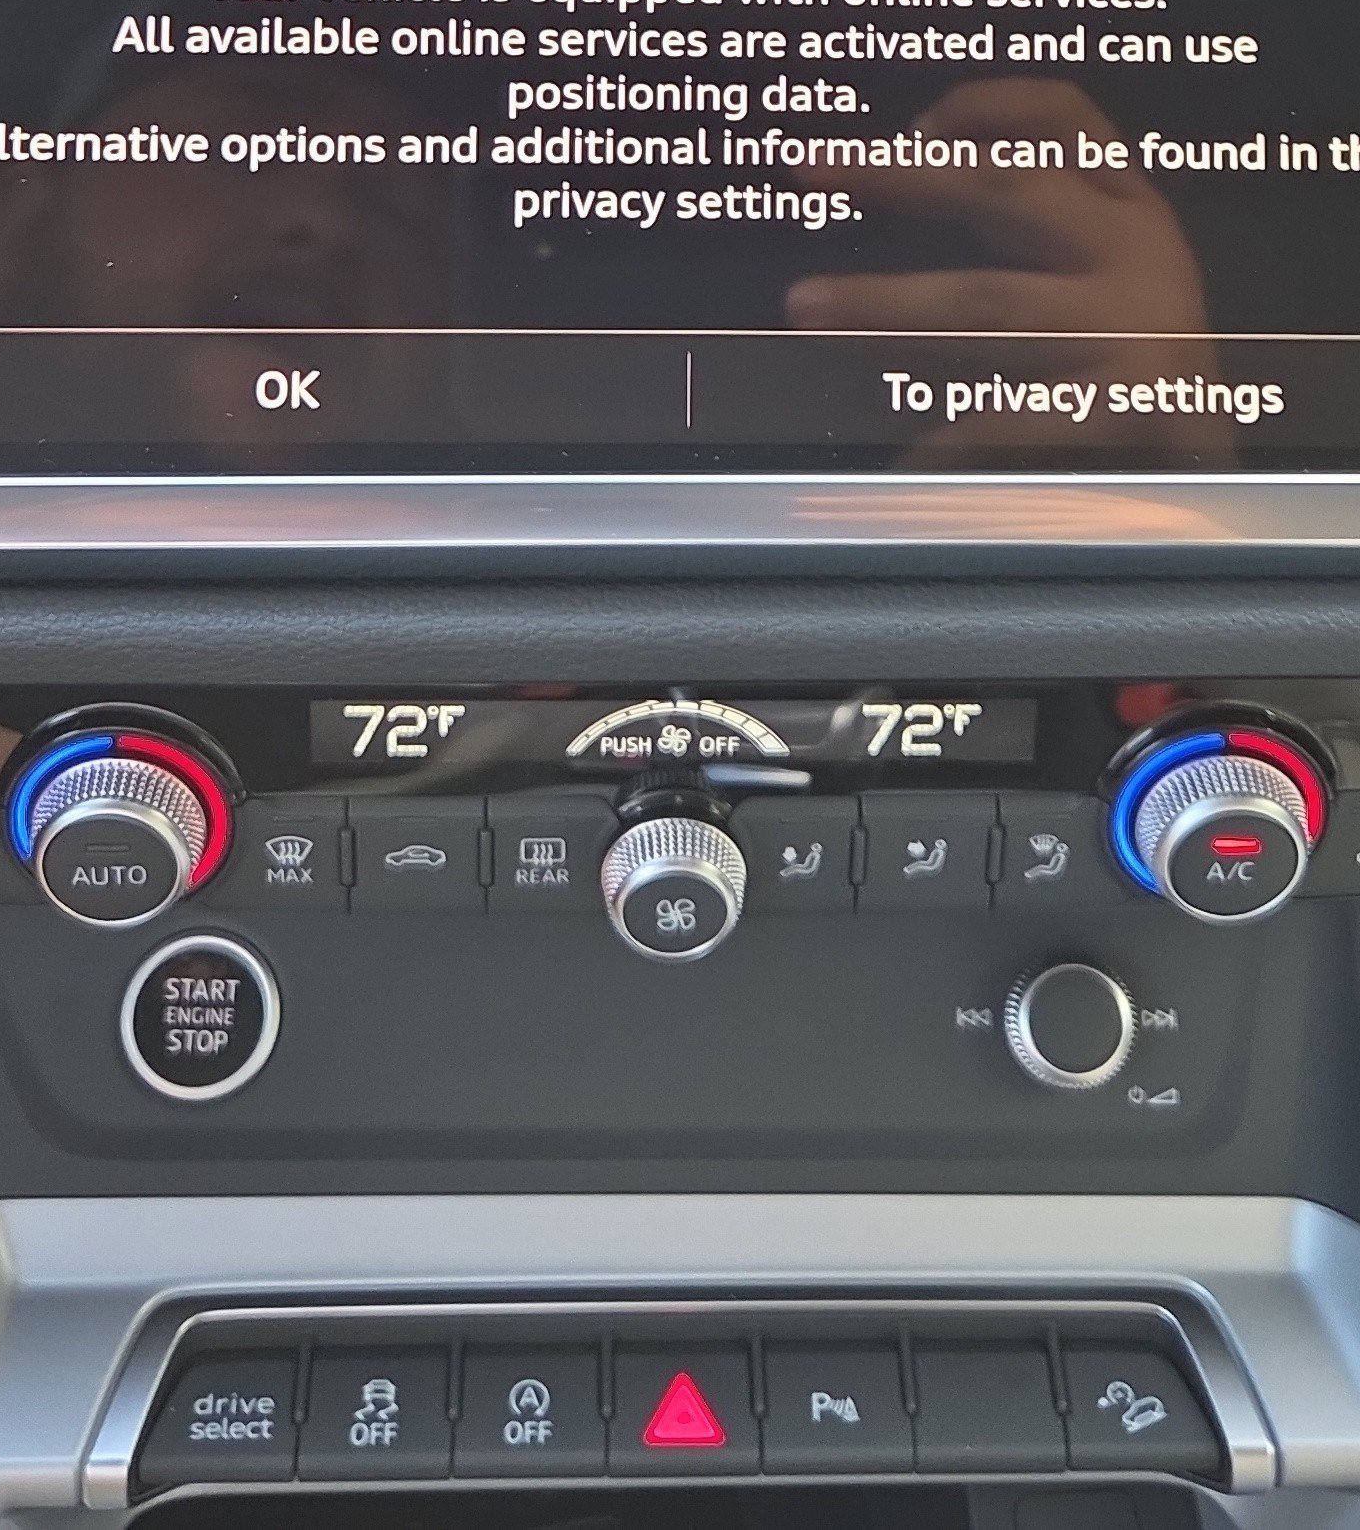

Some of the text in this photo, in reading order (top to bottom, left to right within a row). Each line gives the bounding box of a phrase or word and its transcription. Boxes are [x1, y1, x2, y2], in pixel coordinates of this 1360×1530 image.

[112, 15, 1259, 64] All available online services are activated and can use
[508, 73, 870, 121] positioning data.
[220, 125, 386, 173] options
[398, 125, 478, 164] and
[491, 126, 712, 165] additional
[723, 128, 978, 168] information
[990, 140, 1064, 169] can
[1077, 130, 1129, 169] be
[1138, 131, 1266, 171] found
[1279, 134, 1318, 171] in
[514, 181, 863, 230] privacy settings.
[255, 370, 321, 410] OK
[882, 372, 1285, 424] To privacy settings
[600, 734, 741, 758] PUSH OFF
[71, 864, 148, 887] AUTO
[266, 863, 315, 885] MAX
[515, 864, 570, 886] REAR
[1206, 860, 1257, 883] A/C
[164, 976, 241, 1003] START
[164, 1004, 236, 1028] ENGINE
[165, 1027, 230, 1055] STOP
[193, 1391, 276, 1416] drive
[188, 1416, 276, 1441] select
[348, 1420, 400, 1447] OFF
[502, 1419, 556, 1445] OFF
